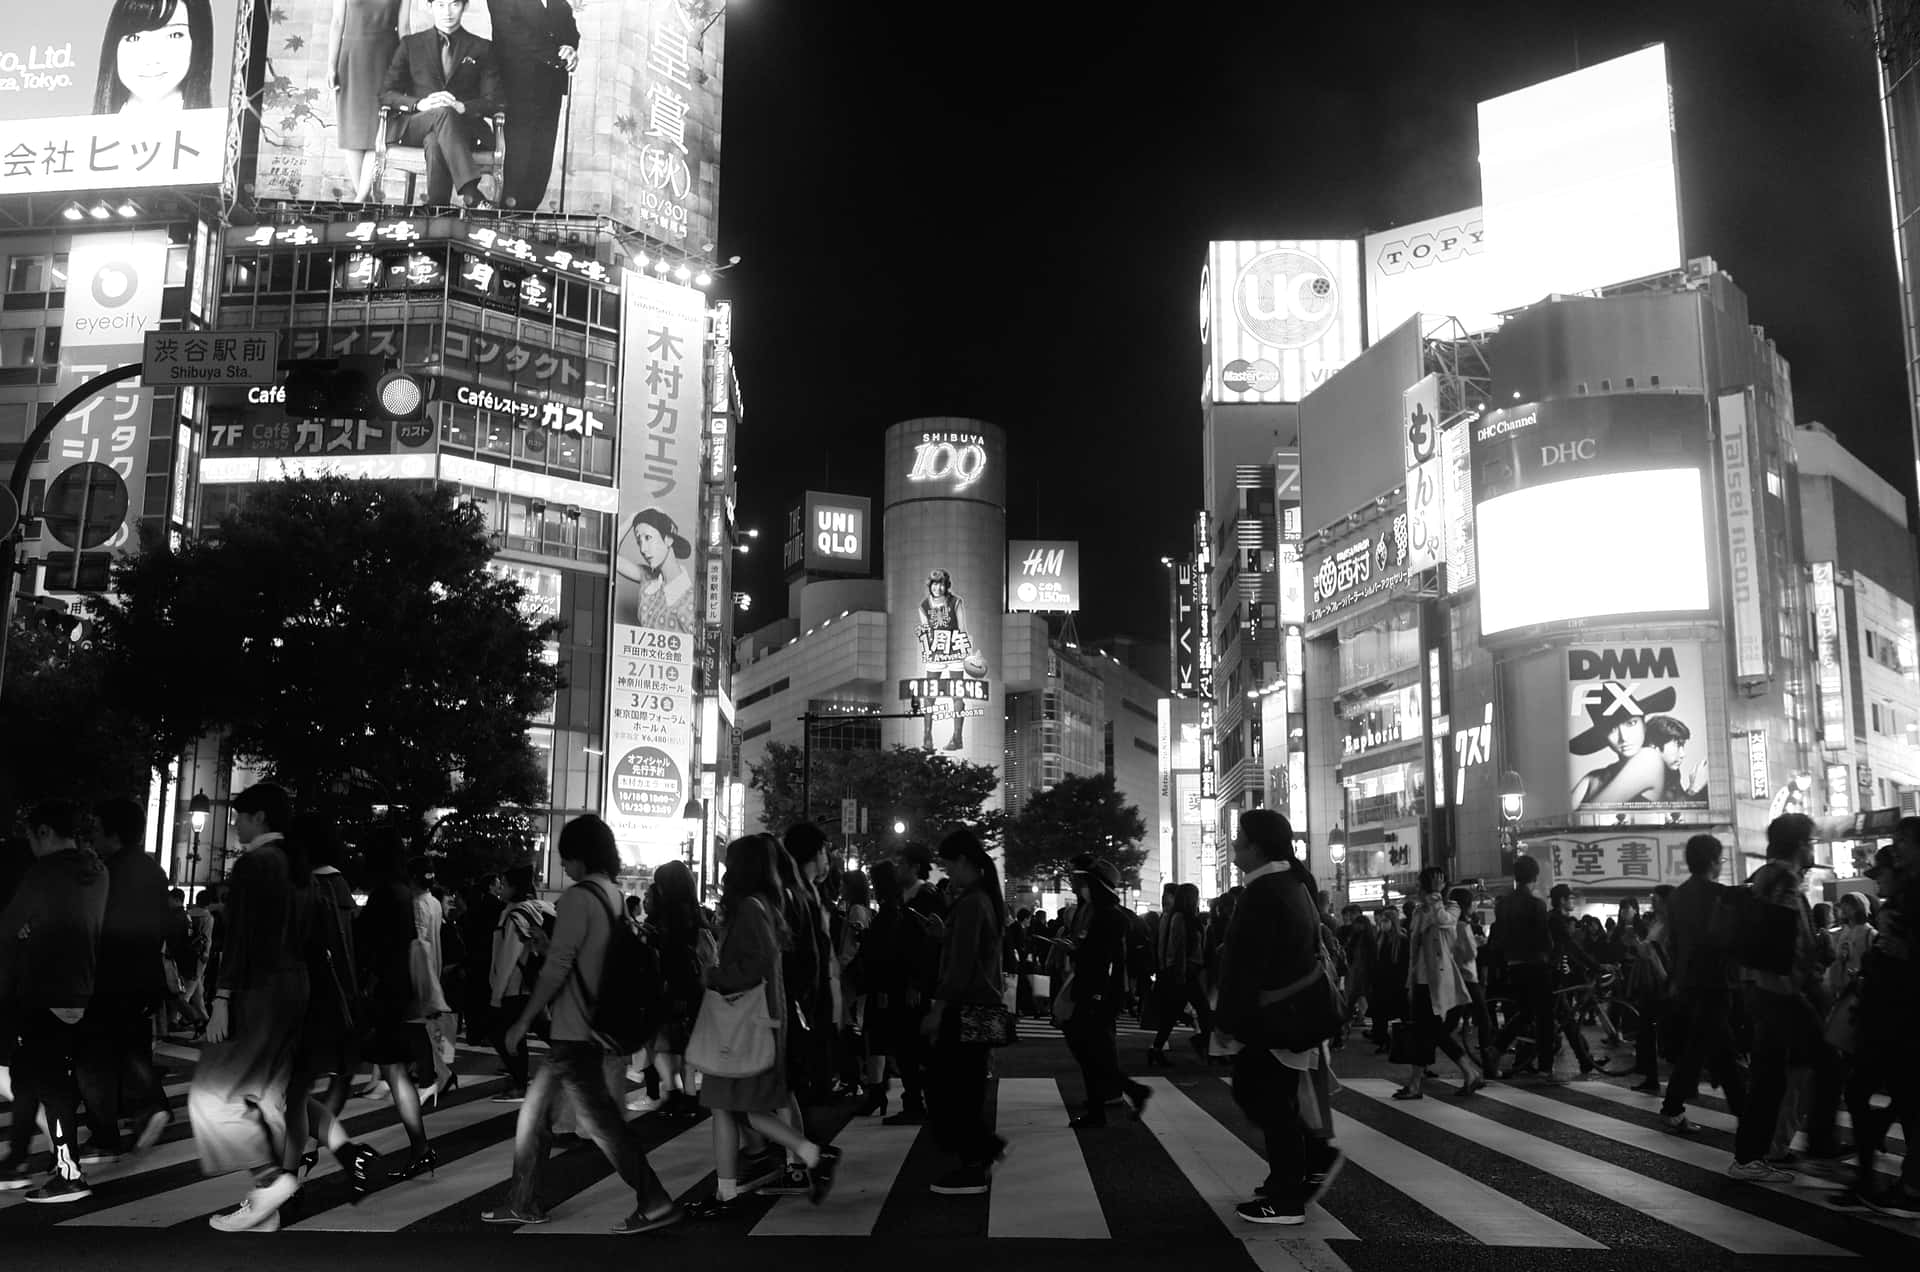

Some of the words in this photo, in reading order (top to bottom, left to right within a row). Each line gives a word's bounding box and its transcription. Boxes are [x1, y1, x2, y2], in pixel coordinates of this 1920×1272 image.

[21, 70, 73, 90] Tokyo.
[4, 131, 200, 176] 会社ヒット
[1386, 230, 1483, 265] TOPY
[75, 312, 147, 334] eyecity
[154, 338, 267, 362] 渋谷駅前
[446, 330, 581, 384] コンタクト
[170, 365, 222, 380] Shibuya
[226, 365, 251, 377] Sta.
[248, 386, 287, 403] Café
[541, 402, 604, 436] ガスト
[643, 326, 684, 498] 木村カエラ
[211, 424, 244, 447] 7F
[252, 421, 290, 439] Café
[294, 418, 384, 453] ガスト
[923, 432, 984, 445] SHIBUYA
[1478, 424, 1497, 441] DHC
[1497, 412, 1537, 434] Channel
[1541, 438, 1596, 466] DHC
[906, 442, 987, 493] 109
[1409, 402, 1440, 560] もんじゃ
[1724, 424, 1749, 517] Taisei
[818, 511, 854, 533] UNI
[818, 532, 857, 554] QLO
[1023, 548, 1064, 576] H&M
[1338, 551, 1370, 591] 西村
[1732, 527, 1751, 602] neon
[623, 645, 682, 662] 戸田市文化会館
[919, 629, 971, 655] 1周年
[1568, 647, 1680, 681] DMM
[618, 676, 685, 693] 神奈川県民ホール
[1571, 682, 1644, 716] FX
[614, 709, 686, 725] 東京国際フォーラム
[1345, 726, 1399, 753] Euphoria
[1456, 702, 1493, 805] クスリ
[628, 754, 671, 768] オフィシャル
[632, 765, 665, 778] 先行予約
